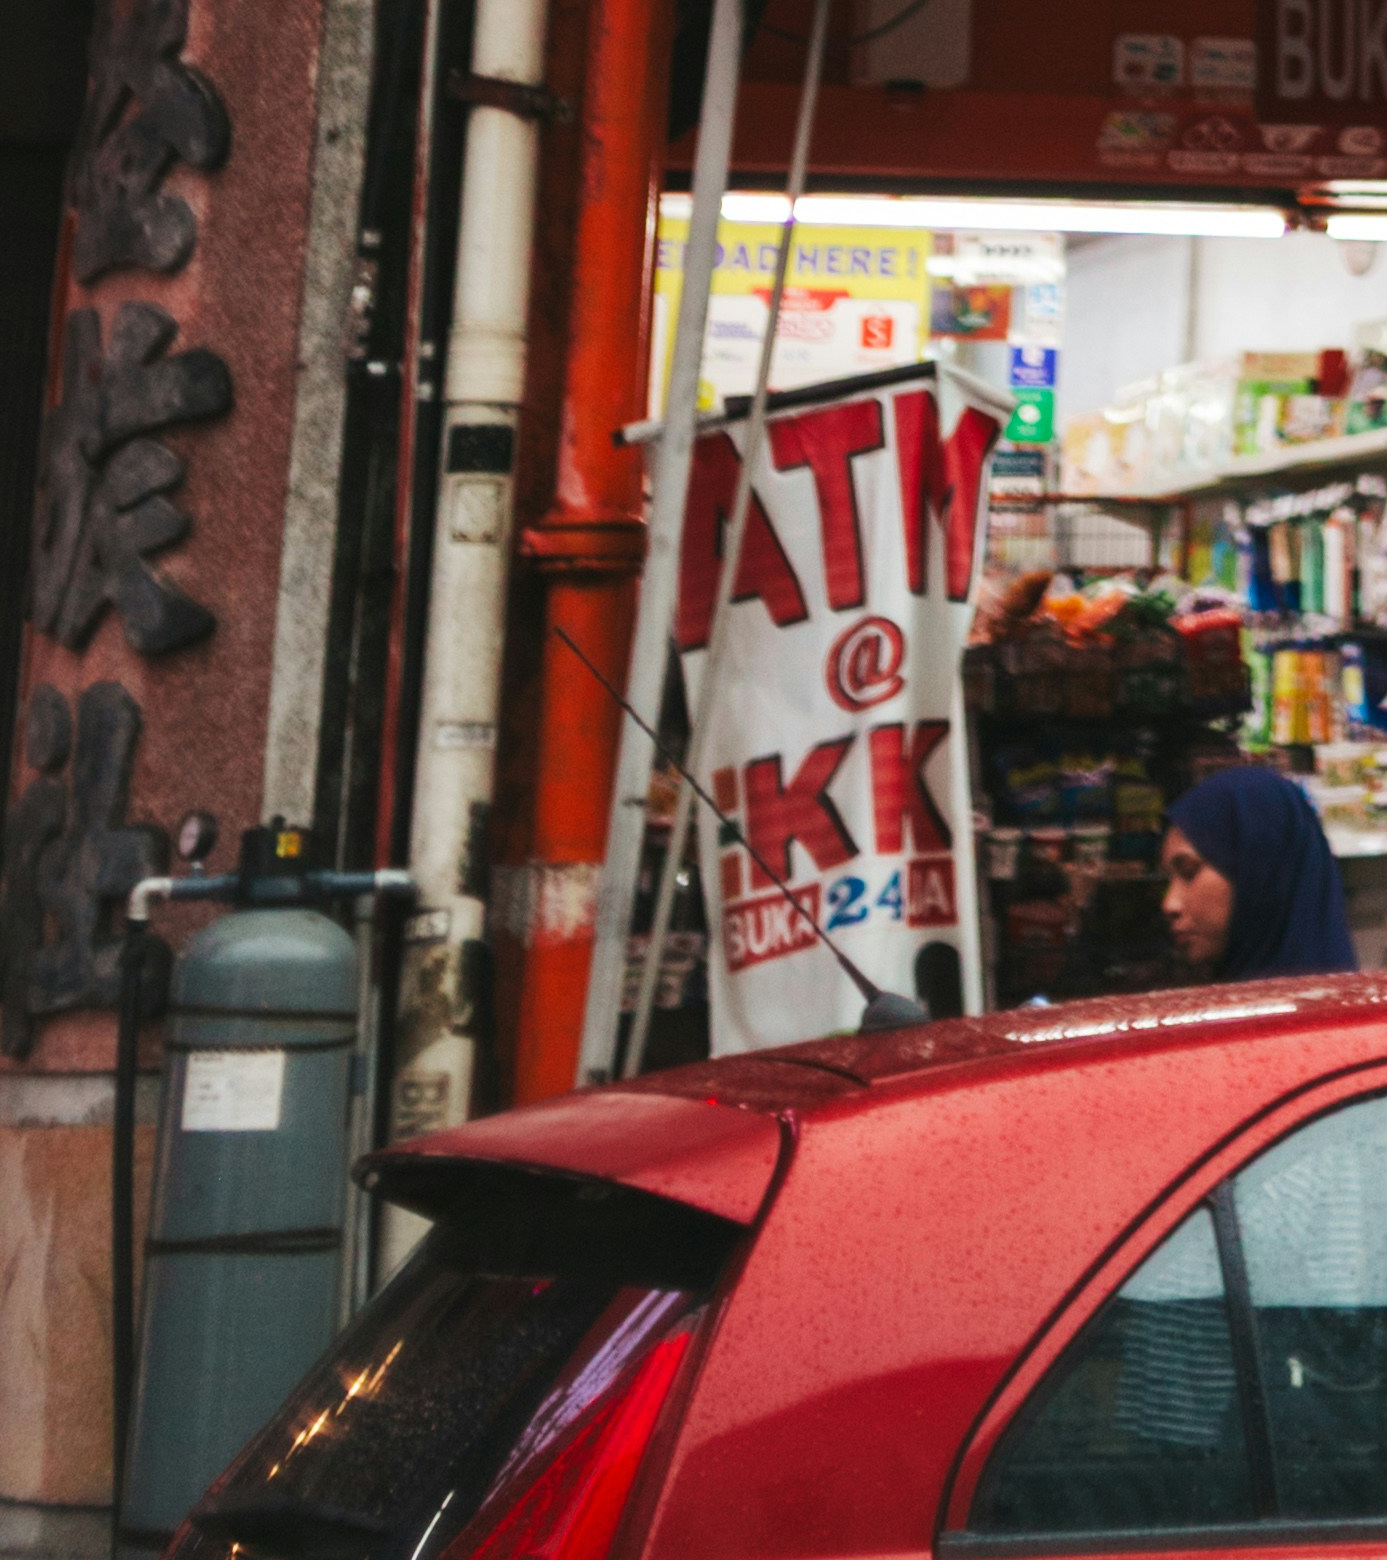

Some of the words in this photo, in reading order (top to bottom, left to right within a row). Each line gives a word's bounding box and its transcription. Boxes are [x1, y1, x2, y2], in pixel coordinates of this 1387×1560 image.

[676, 389, 998, 651] ATM
[825, 615, 907, 713] @
[744, 716, 953, 891] KK
[825, 870, 903, 933] 24
